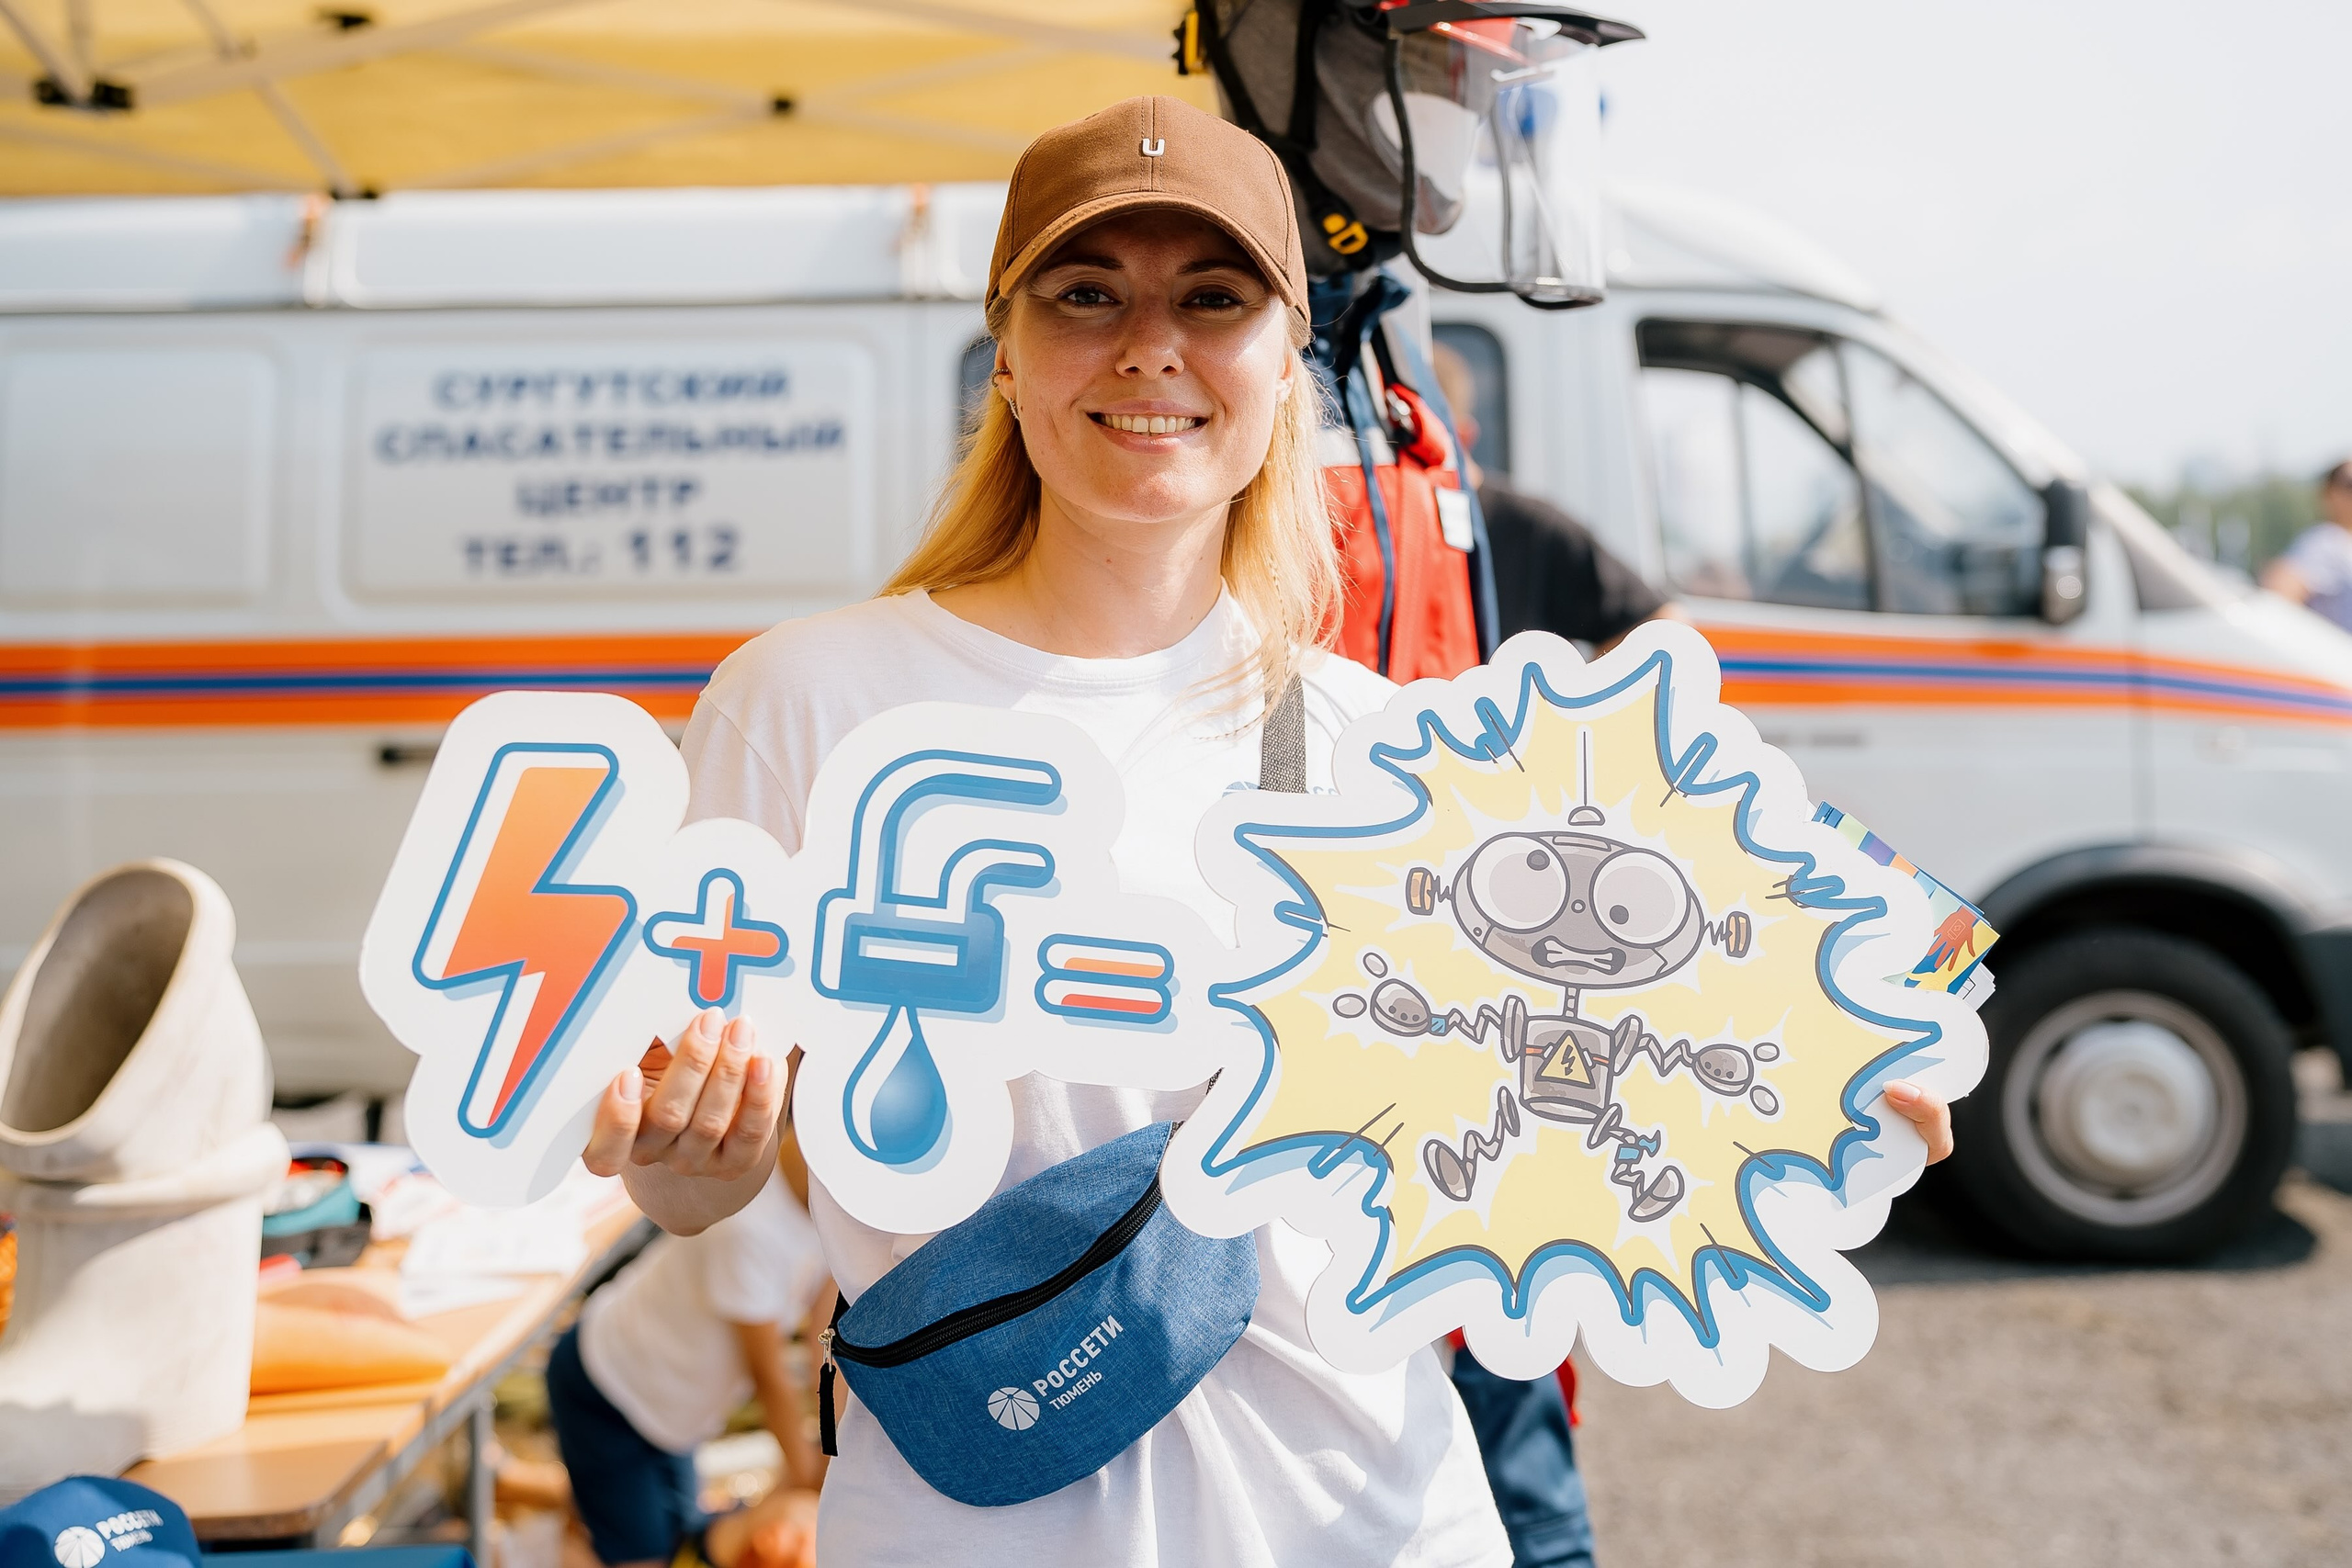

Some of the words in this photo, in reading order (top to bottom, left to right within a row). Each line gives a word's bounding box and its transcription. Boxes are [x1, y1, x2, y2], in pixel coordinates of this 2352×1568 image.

[433, 368, 790, 410] СУРГУТСКИЙ
[377, 416, 844, 465] СПАСАТЕЛЬНЫЙ
[515, 476, 703, 517] ЦЕНТР
[630, 524, 741, 573] 112
[1032, 1314, 1124, 1397] РОССЕТИ
[1049, 1371, 1102, 1410] ТЮМЕНЬ
